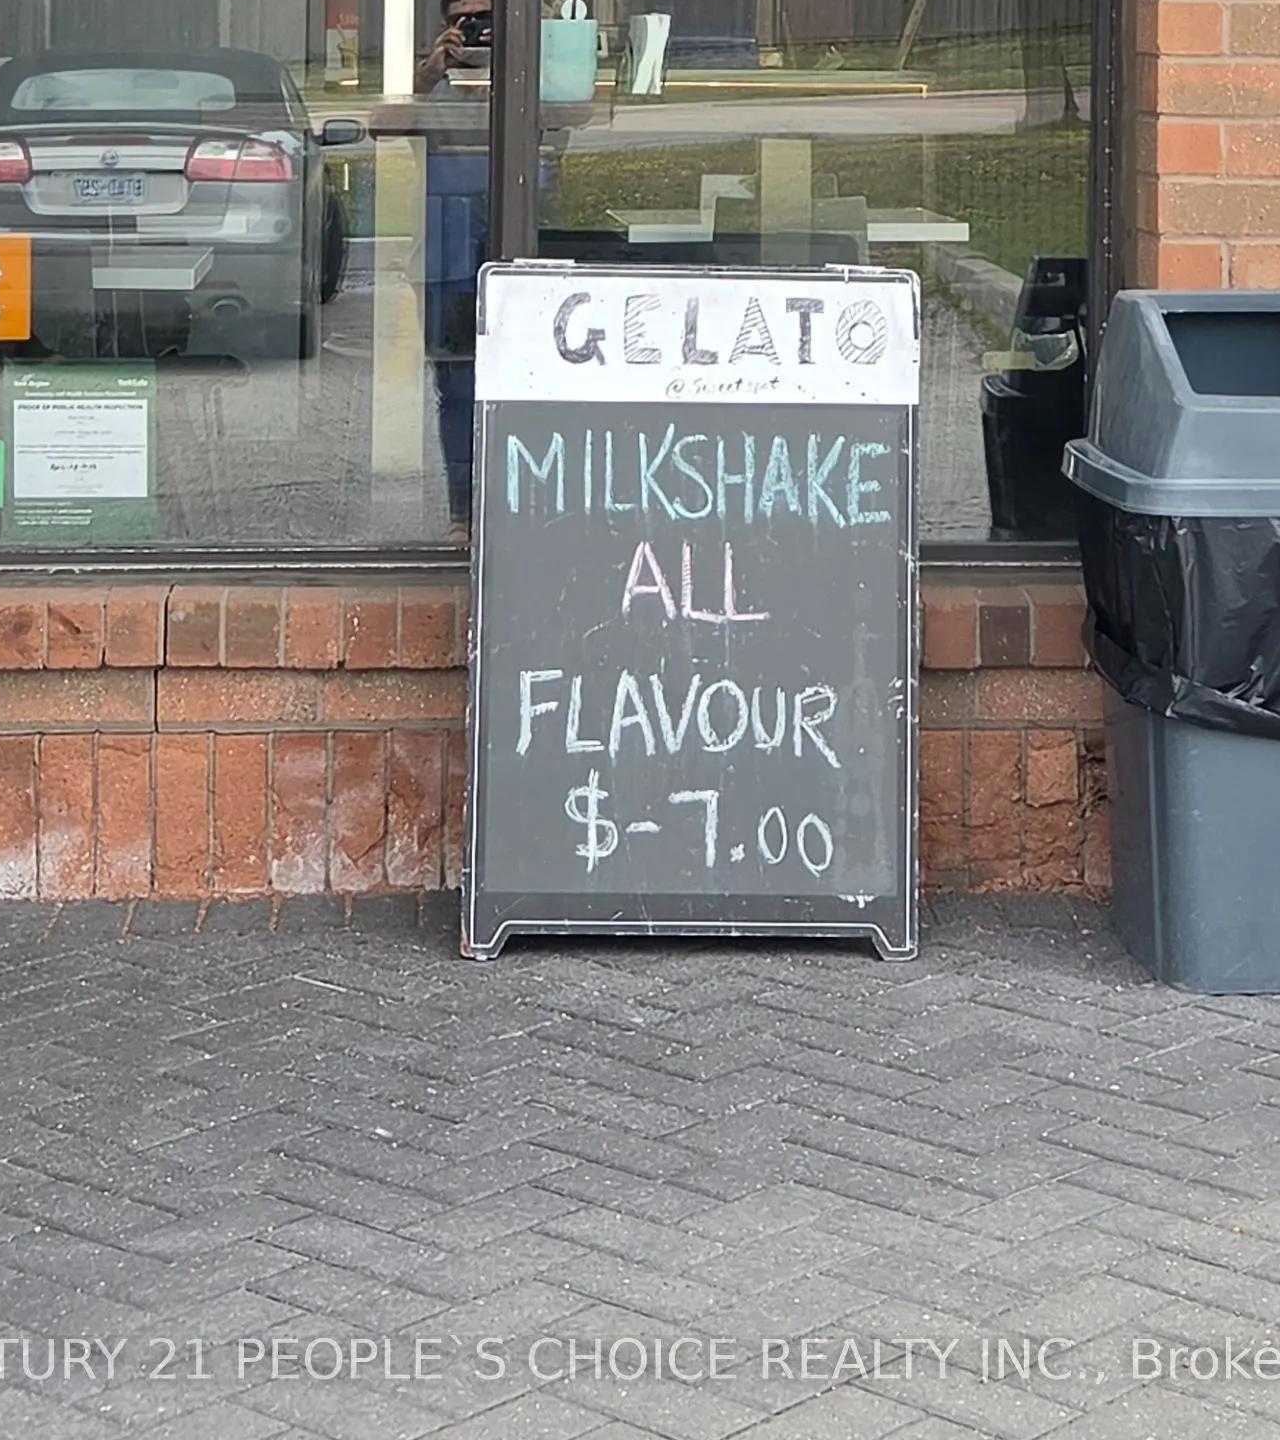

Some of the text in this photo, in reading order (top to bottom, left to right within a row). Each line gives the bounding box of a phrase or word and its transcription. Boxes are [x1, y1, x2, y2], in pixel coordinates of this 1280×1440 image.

[552, 291, 888, 366] GELATO
[506, 423, 891, 528] MILKSHAKE
[621, 540, 770, 623] ALL
[516, 668, 841, 769] FLAVOUR
